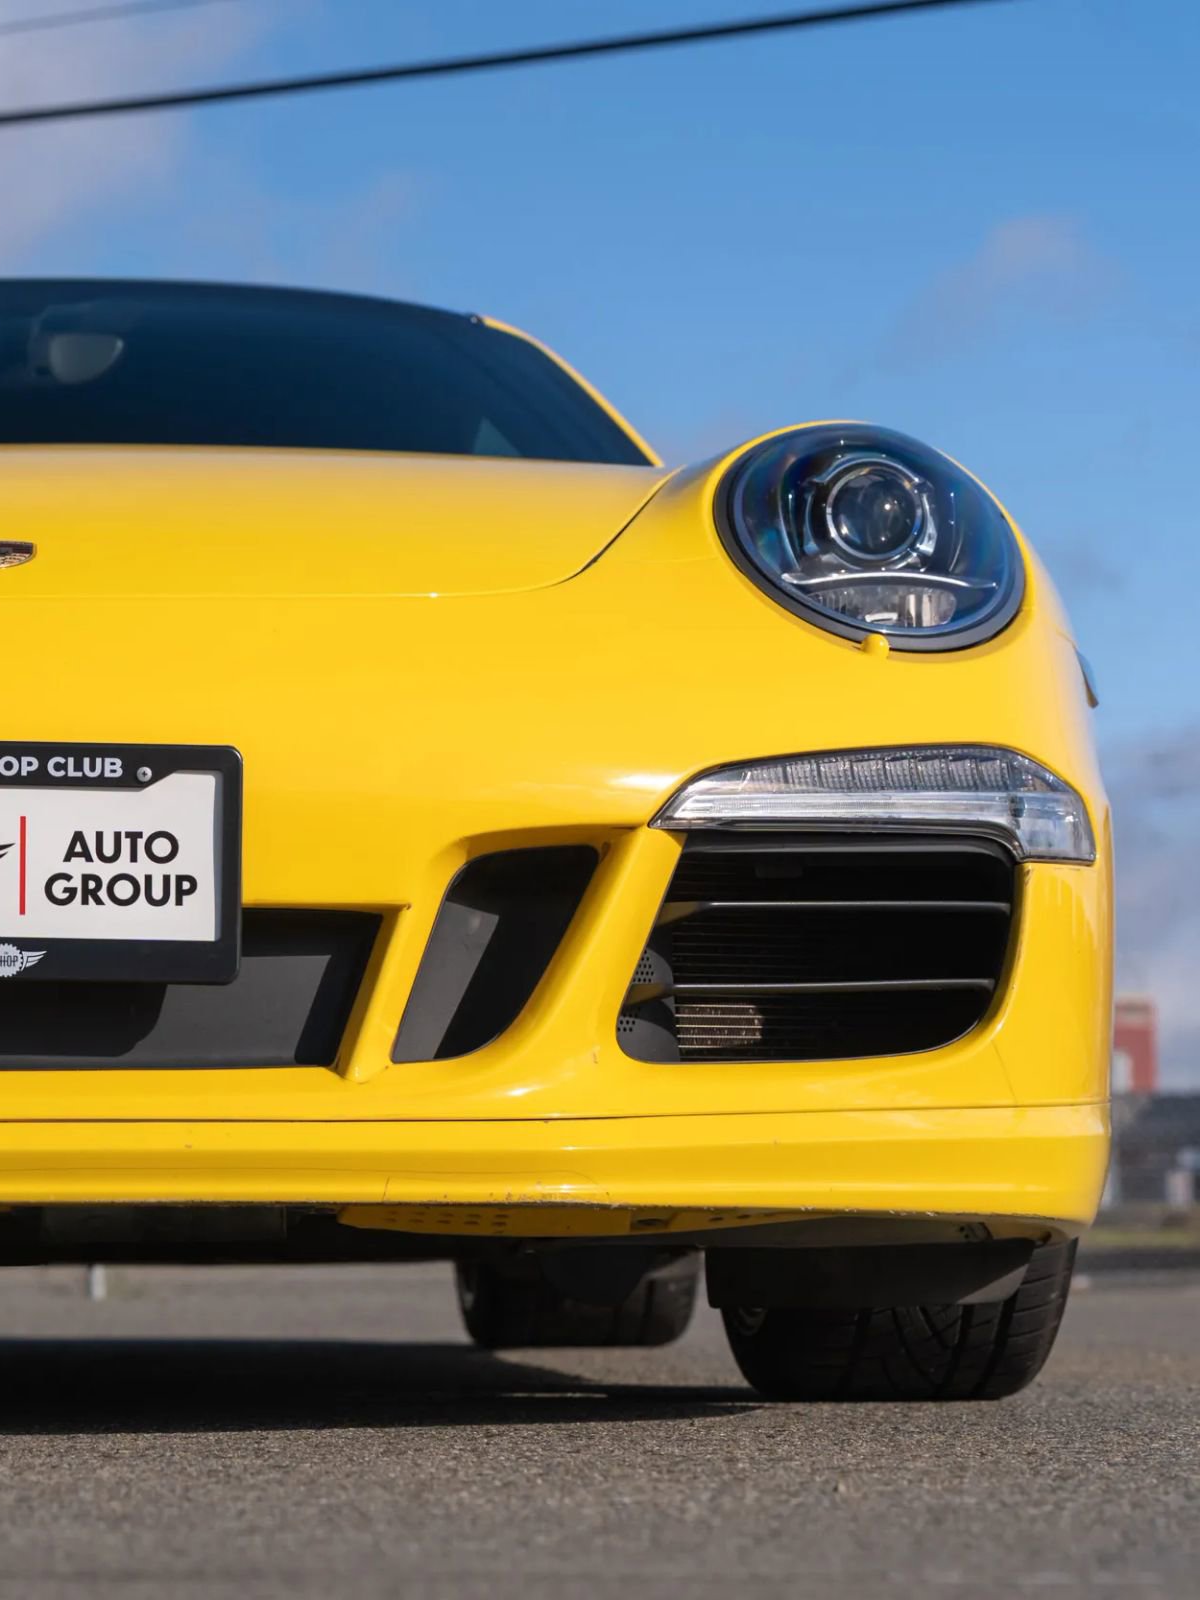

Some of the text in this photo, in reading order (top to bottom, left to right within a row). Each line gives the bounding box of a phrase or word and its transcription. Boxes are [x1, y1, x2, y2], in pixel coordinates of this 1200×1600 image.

[47, 756, 123, 778] CLUB
[62, 830, 180, 864] AUTO
[44, 872, 198, 907] GROUP
